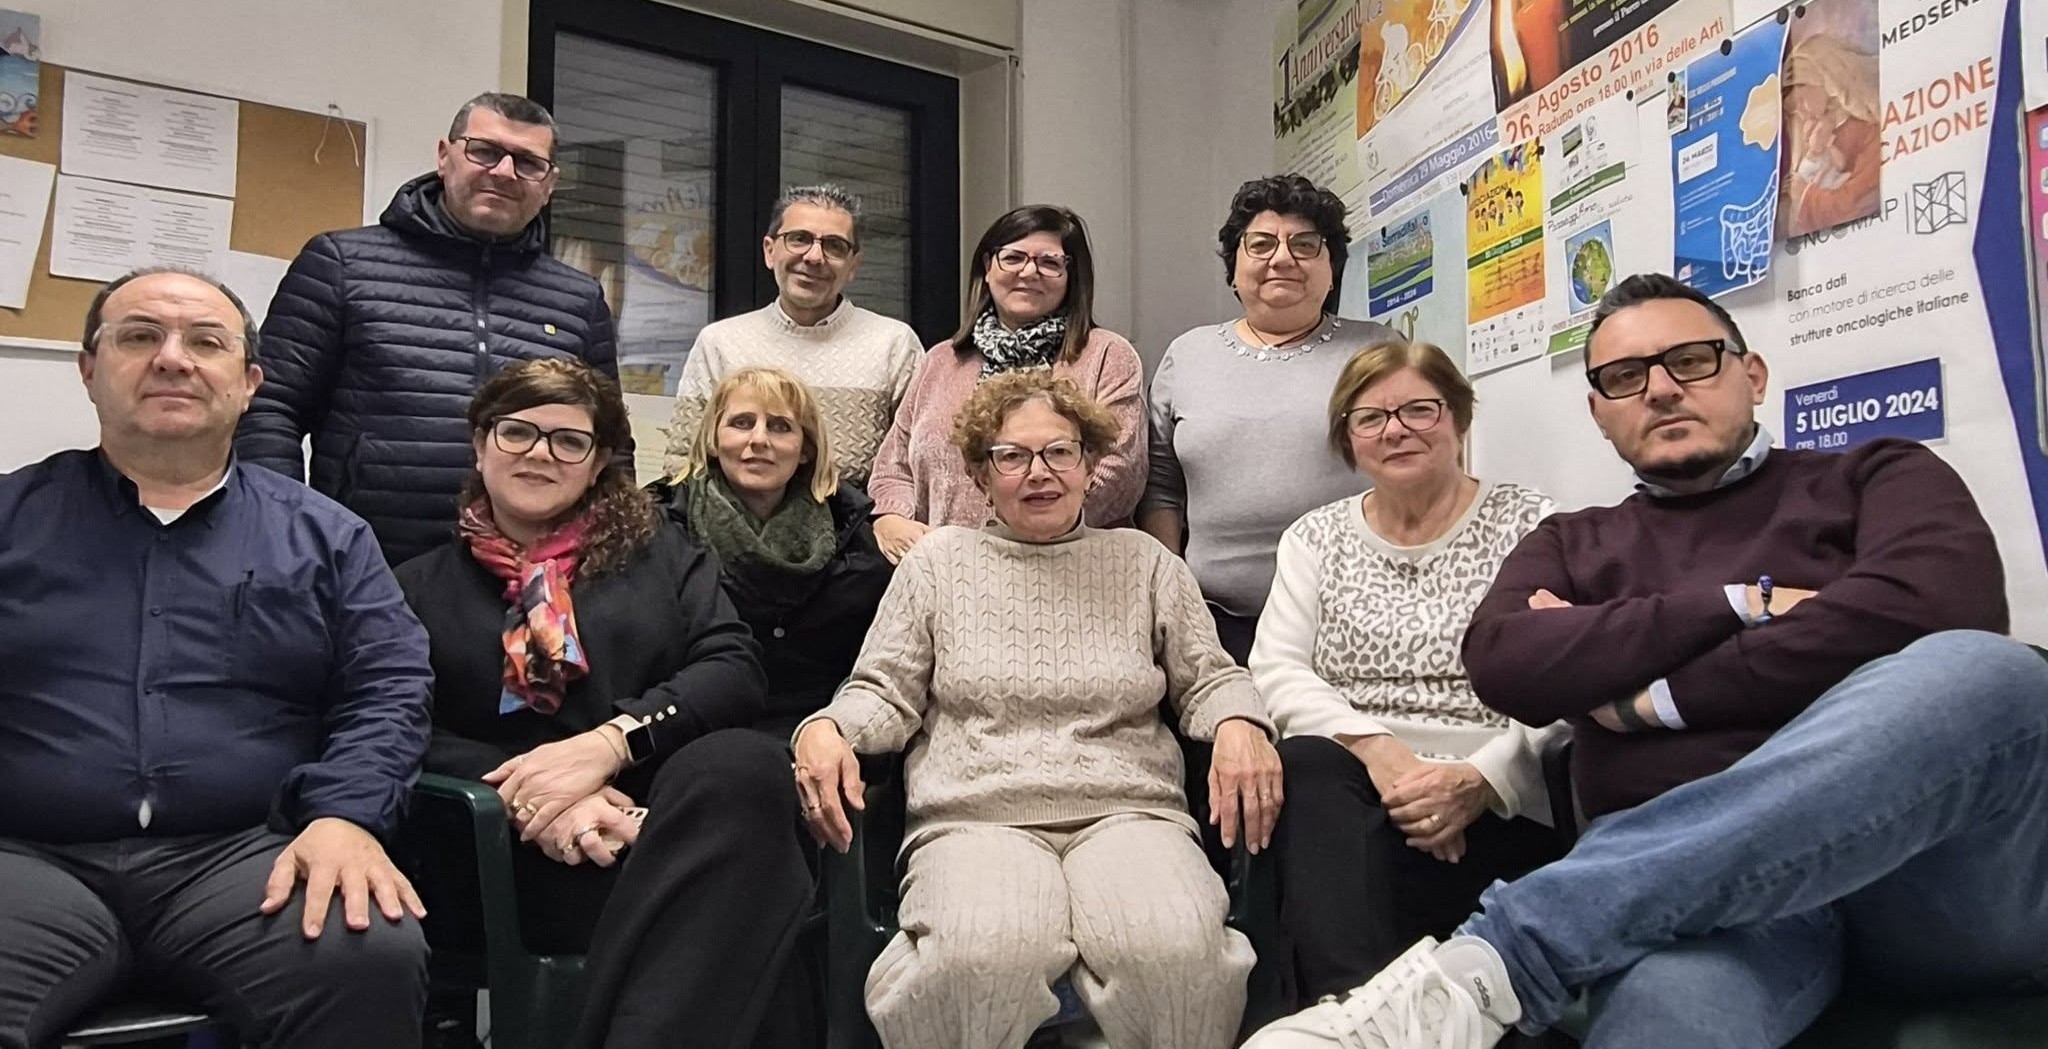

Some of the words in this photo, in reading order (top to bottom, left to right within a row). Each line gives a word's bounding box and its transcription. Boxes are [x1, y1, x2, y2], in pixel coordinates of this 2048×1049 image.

[1537, 65, 1602, 117] Agosto
[1608, 23, 1660, 73] 2016
[1538, 108, 1574, 136] Raduno
[1576, 97, 1595, 114] ore
[1598, 74, 1627, 101] 18.00
[1630, 69, 1642, 84] in
[1645, 57, 1663, 74] via
[1666, 37, 1697, 63] delle
[1700, 17, 1724, 44] Arti
[1429, 143, 1467, 172] Maggio
[1467, 123, 1493, 152] 2016
[1787, 283, 1823, 302] Banca
[1825, 272, 1848, 291] dati
[1788, 309, 1810, 324] con
[1812, 297, 1854, 316] motore
[1857, 289, 1868, 305] di
[1871, 280, 1916, 300] ricerca
[1920, 269, 1955, 288] delle
[1790, 327, 1833, 347] strutture
[1836, 305, 1914, 335] oncologiche
[1916, 291, 1970, 315] italiane
[1795, 385, 1839, 407] Venerdì
[1796, 412, 1808, 433] 5
[1811, 398, 1881, 431] LUGLIO
[1885, 386, 1939, 418] 2024
[1795, 439, 1815, 450] ore
[1818, 431, 1848, 448] 18.00
